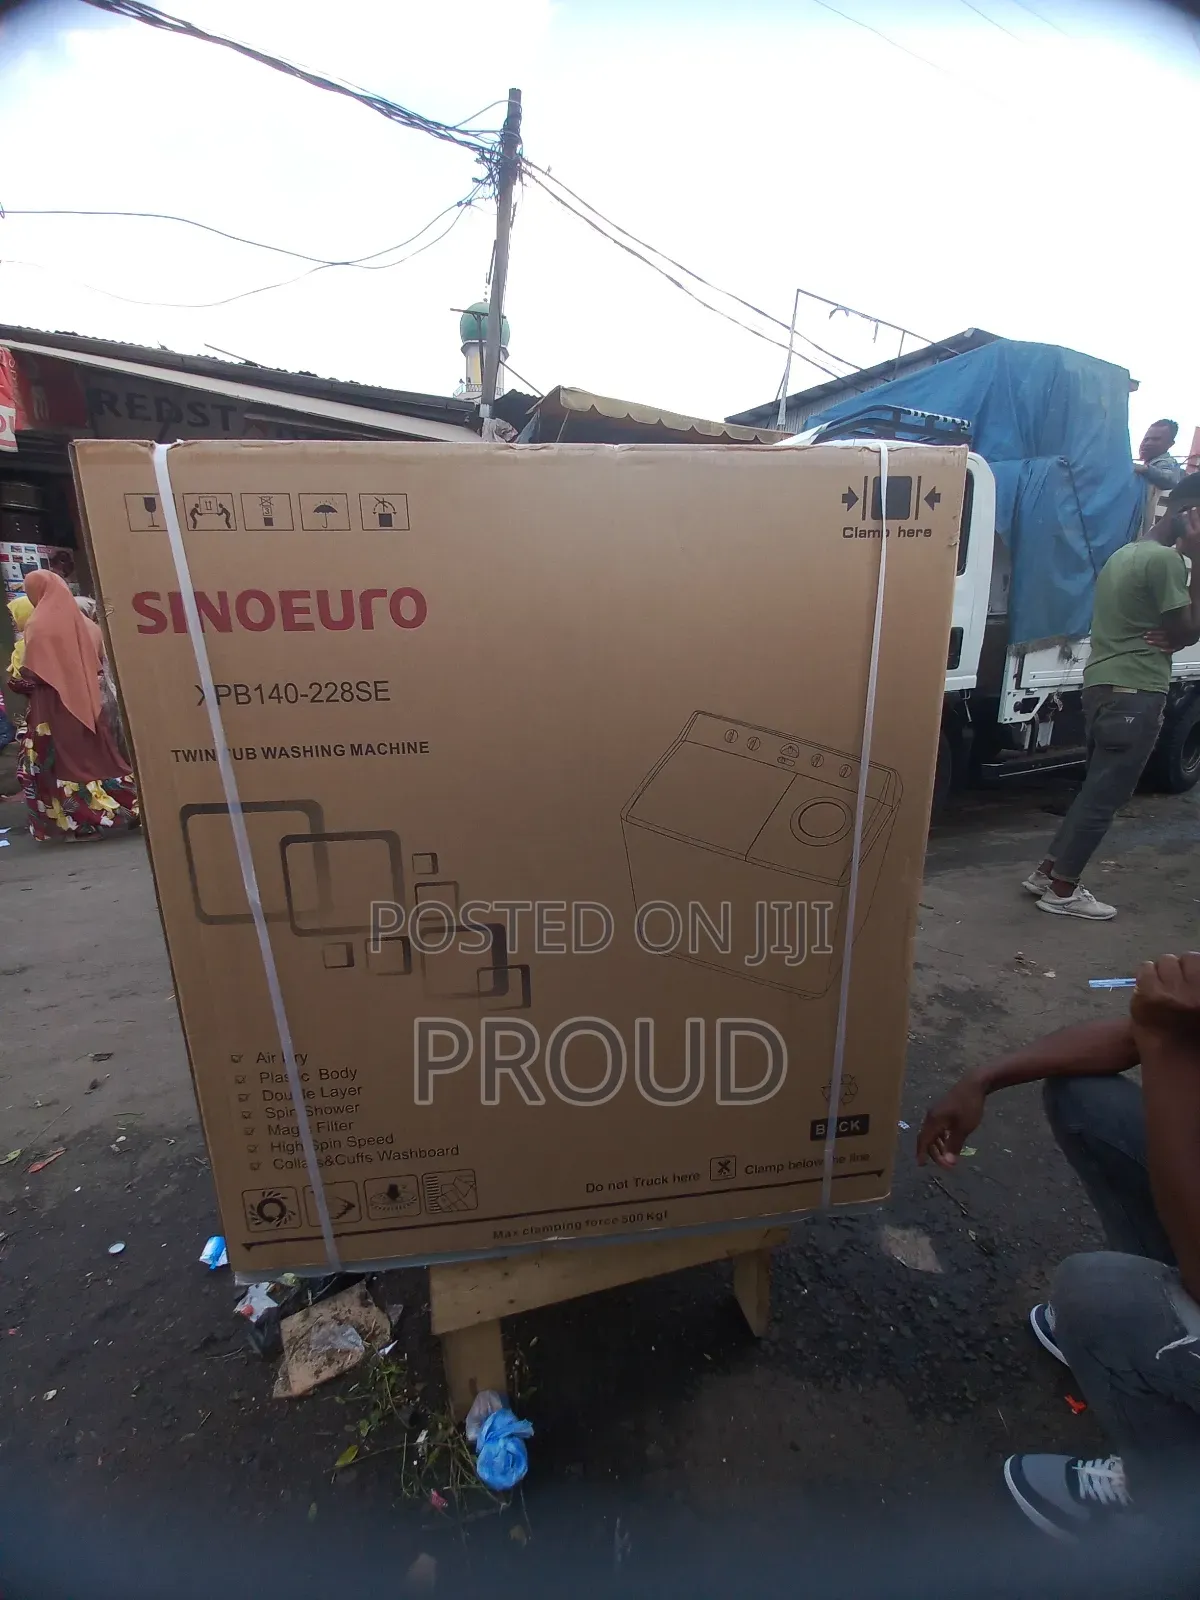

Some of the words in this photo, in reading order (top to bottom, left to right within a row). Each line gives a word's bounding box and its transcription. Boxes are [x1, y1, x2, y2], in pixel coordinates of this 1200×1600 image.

[897, 526, 932, 538] here
[171, 749, 217, 763] TWIN
[228, 747, 258, 761] UB
[261, 743, 346, 760] WASHING
[350, 741, 430, 757] MACHINE
[256, 1052, 275, 1064] Air
[282, 1052, 308, 1067] ry
[259, 1072, 310, 1084] Plasc
[319, 1067, 358, 1083] Body
[262, 1088, 315, 1102] Doule
[321, 1084, 363, 1101] Layer
[304, 1103, 360, 1117] Shower
[317, 1121, 354, 1133] Filter
[815, 1120, 861, 1136] BCK
[270, 1141, 304, 1156] High
[310, 1138, 342, 1153] Spin
[347, 1133, 394, 1149] Speed
[273, 1153, 373, 1170] Collas&Cuffs
[378, 1145, 460, 1162] Washboard
[744, 1162, 785, 1176] Clamp
[788, 1157, 825, 1170] below
[830, 1154, 846, 1164] he
[850, 1152, 870, 1162] line
[585, 1182, 604, 1193] Do
[608, 1180, 629, 1191] not
[633, 1175, 669, 1188] Truck
[672, 1171, 701, 1182] here
[493, 1229, 519, 1240] Max
[522, 1221, 582, 1237] clamping
[585, 1215, 619, 1227] force
[621, 1213, 644, 1224] 500
